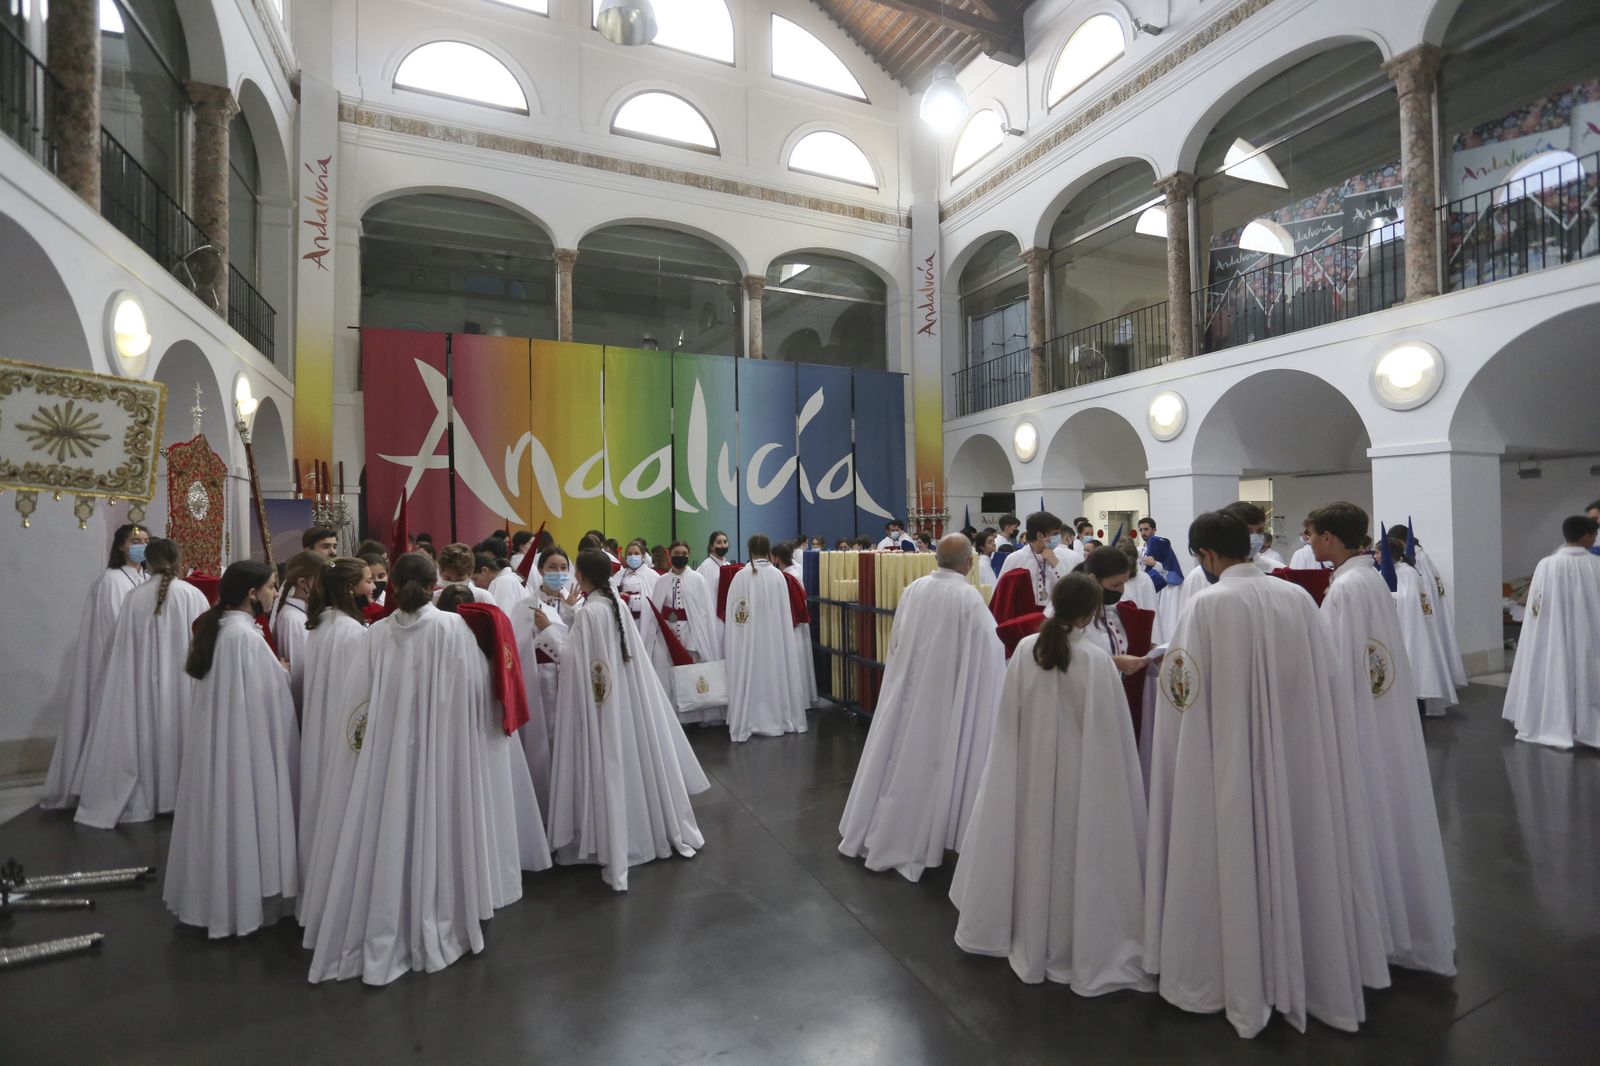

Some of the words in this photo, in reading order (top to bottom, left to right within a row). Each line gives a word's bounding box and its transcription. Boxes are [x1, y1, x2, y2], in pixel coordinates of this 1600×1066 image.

[302, 154, 332, 272] Andalucía
[917, 250, 937, 337] Andalucía
[376, 357, 896, 526] Andalucía
